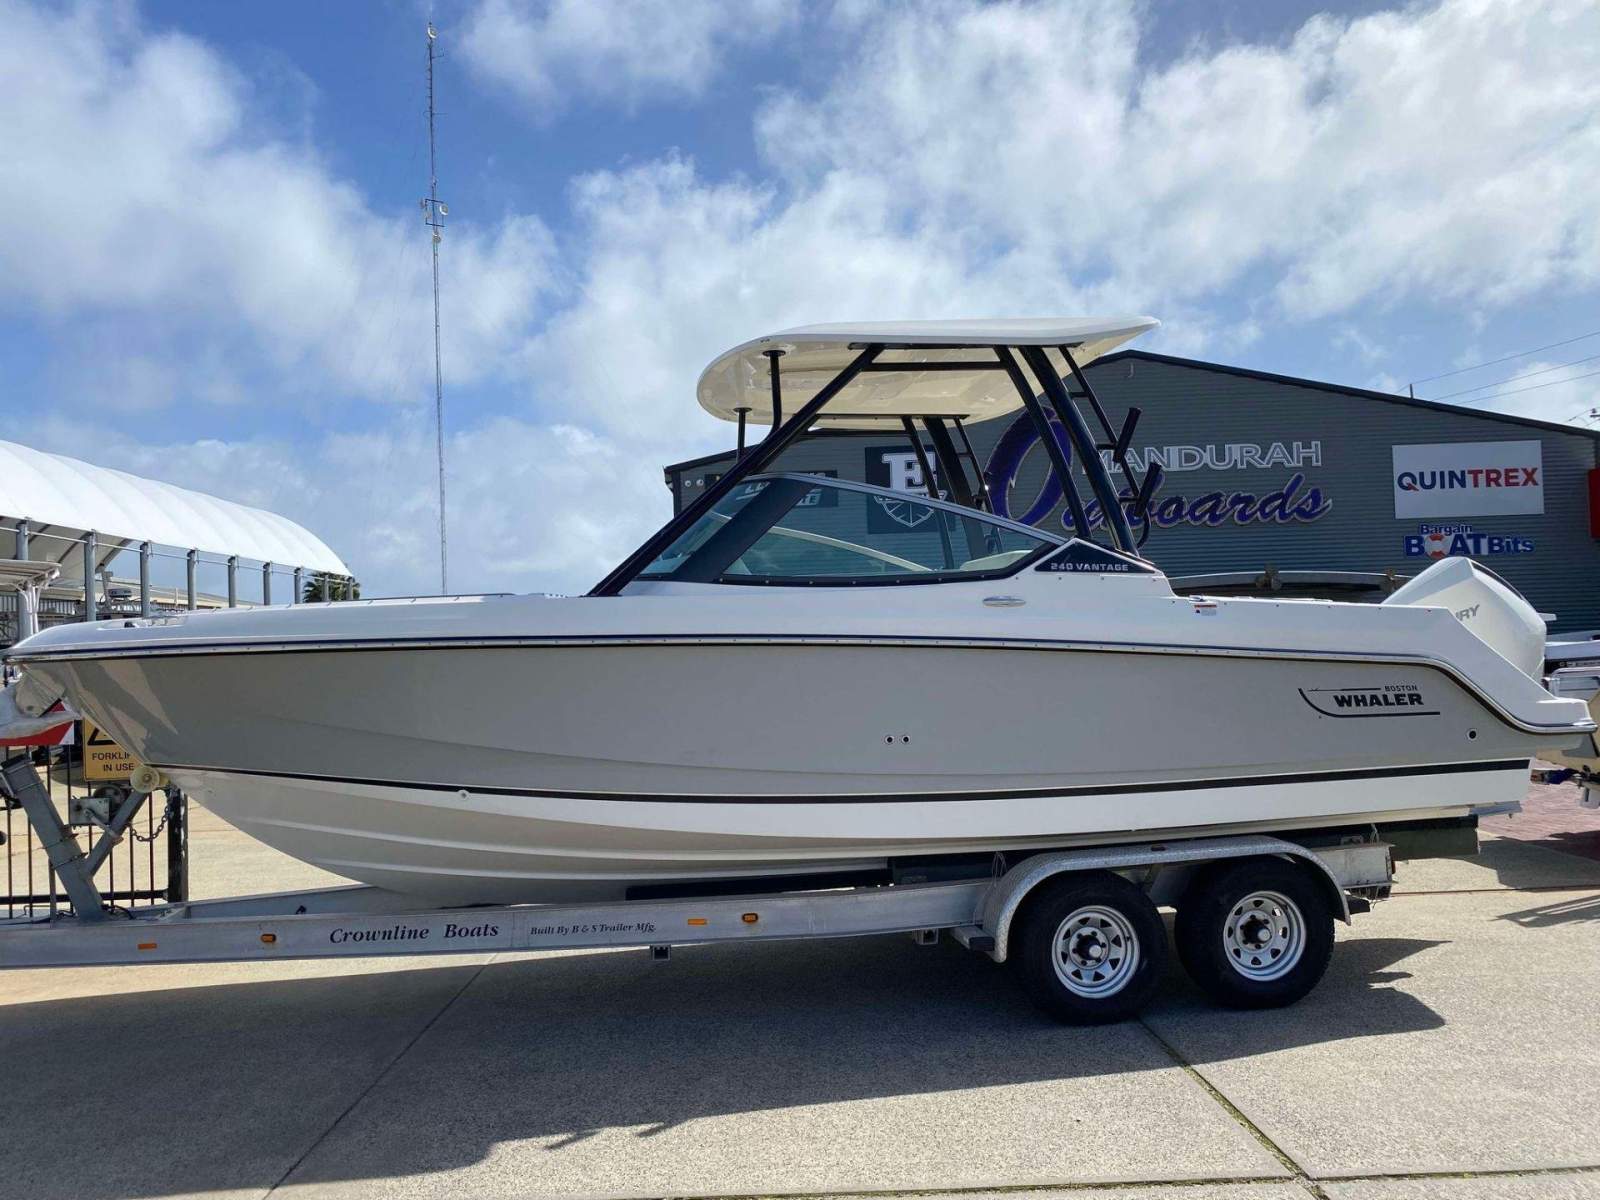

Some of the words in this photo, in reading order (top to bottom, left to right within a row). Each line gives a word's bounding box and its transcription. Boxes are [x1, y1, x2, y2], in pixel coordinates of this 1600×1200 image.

[983, 405, 1333, 534] Ouboards
[1397, 467, 1539, 492] QUINTREX
[1420, 524, 1473, 537] Bargain
[1050, 562, 1073, 571] 240
[1075, 563, 1129, 572] VANTAGE
[1333, 693, 1424, 708] WHALER
[103, 763, 113, 772] IN
[115, 762, 135, 772] USE
[329, 925, 430, 944] Crownline
[443, 923, 499, 939] Boats
[530, 926, 555, 935] Built
[557, 925, 570, 936] By
[571, 925, 580, 934] B
[581, 924, 591, 933] &
[591, 924, 598, 933] S
[599, 923, 634, 933] Trailer
